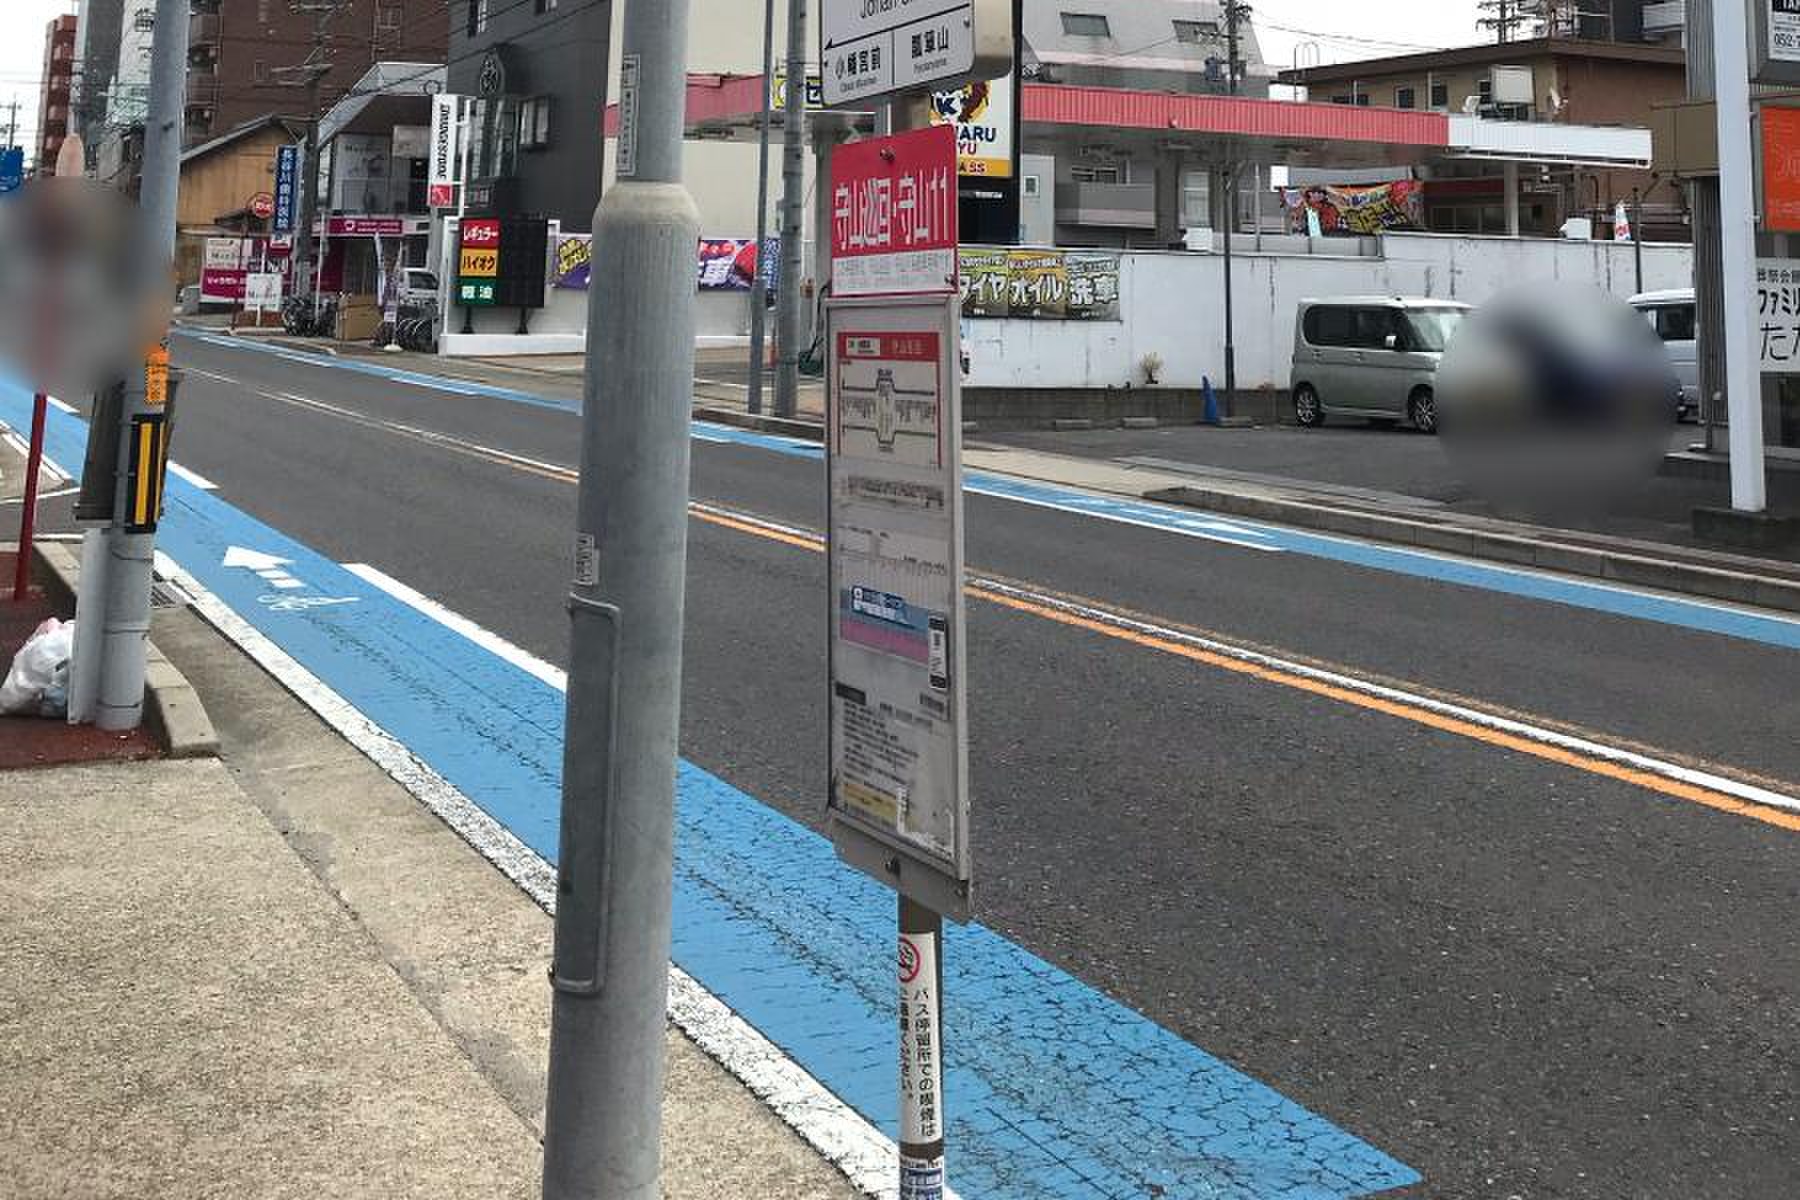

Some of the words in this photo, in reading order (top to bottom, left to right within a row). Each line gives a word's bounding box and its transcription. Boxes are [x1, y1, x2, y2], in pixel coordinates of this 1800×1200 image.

[956, 126, 996, 143] ARU
[463, 255, 496, 271] ハイオク
